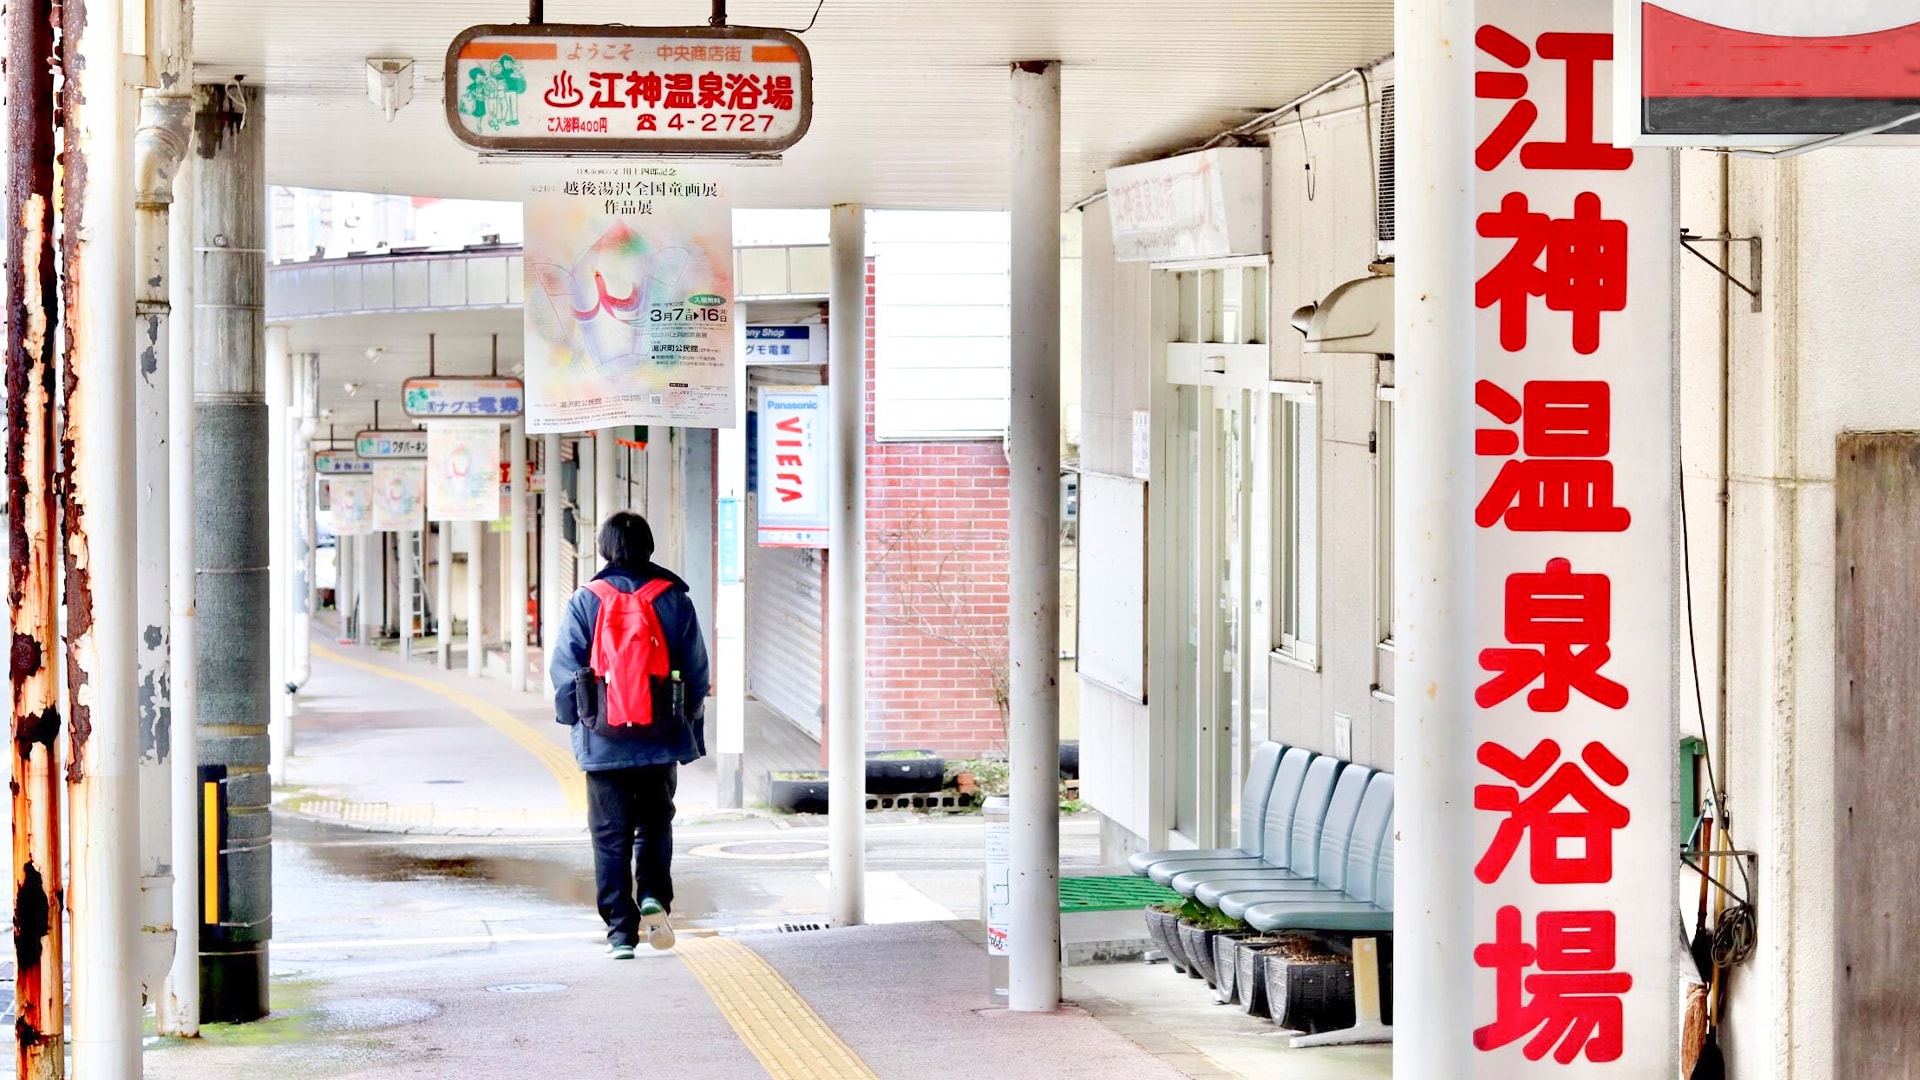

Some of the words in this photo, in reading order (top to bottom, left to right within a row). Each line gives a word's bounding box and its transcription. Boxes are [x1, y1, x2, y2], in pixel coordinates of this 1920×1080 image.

[566, 43, 633, 61] ようこそ
[657, 44, 742, 62] 中央商店街
[588, 70, 794, 111] 江神温泉浴場
[547, 117, 608, 133] ご入浴料400円
[667, 113, 775, 132] 4-2727
[604, 199, 653, 215] 作品展
[762, 328, 785, 338] Shop
[767, 400, 819, 410] Panasonic
[1474, 24, 1634, 1065] 江神温泉浴場
